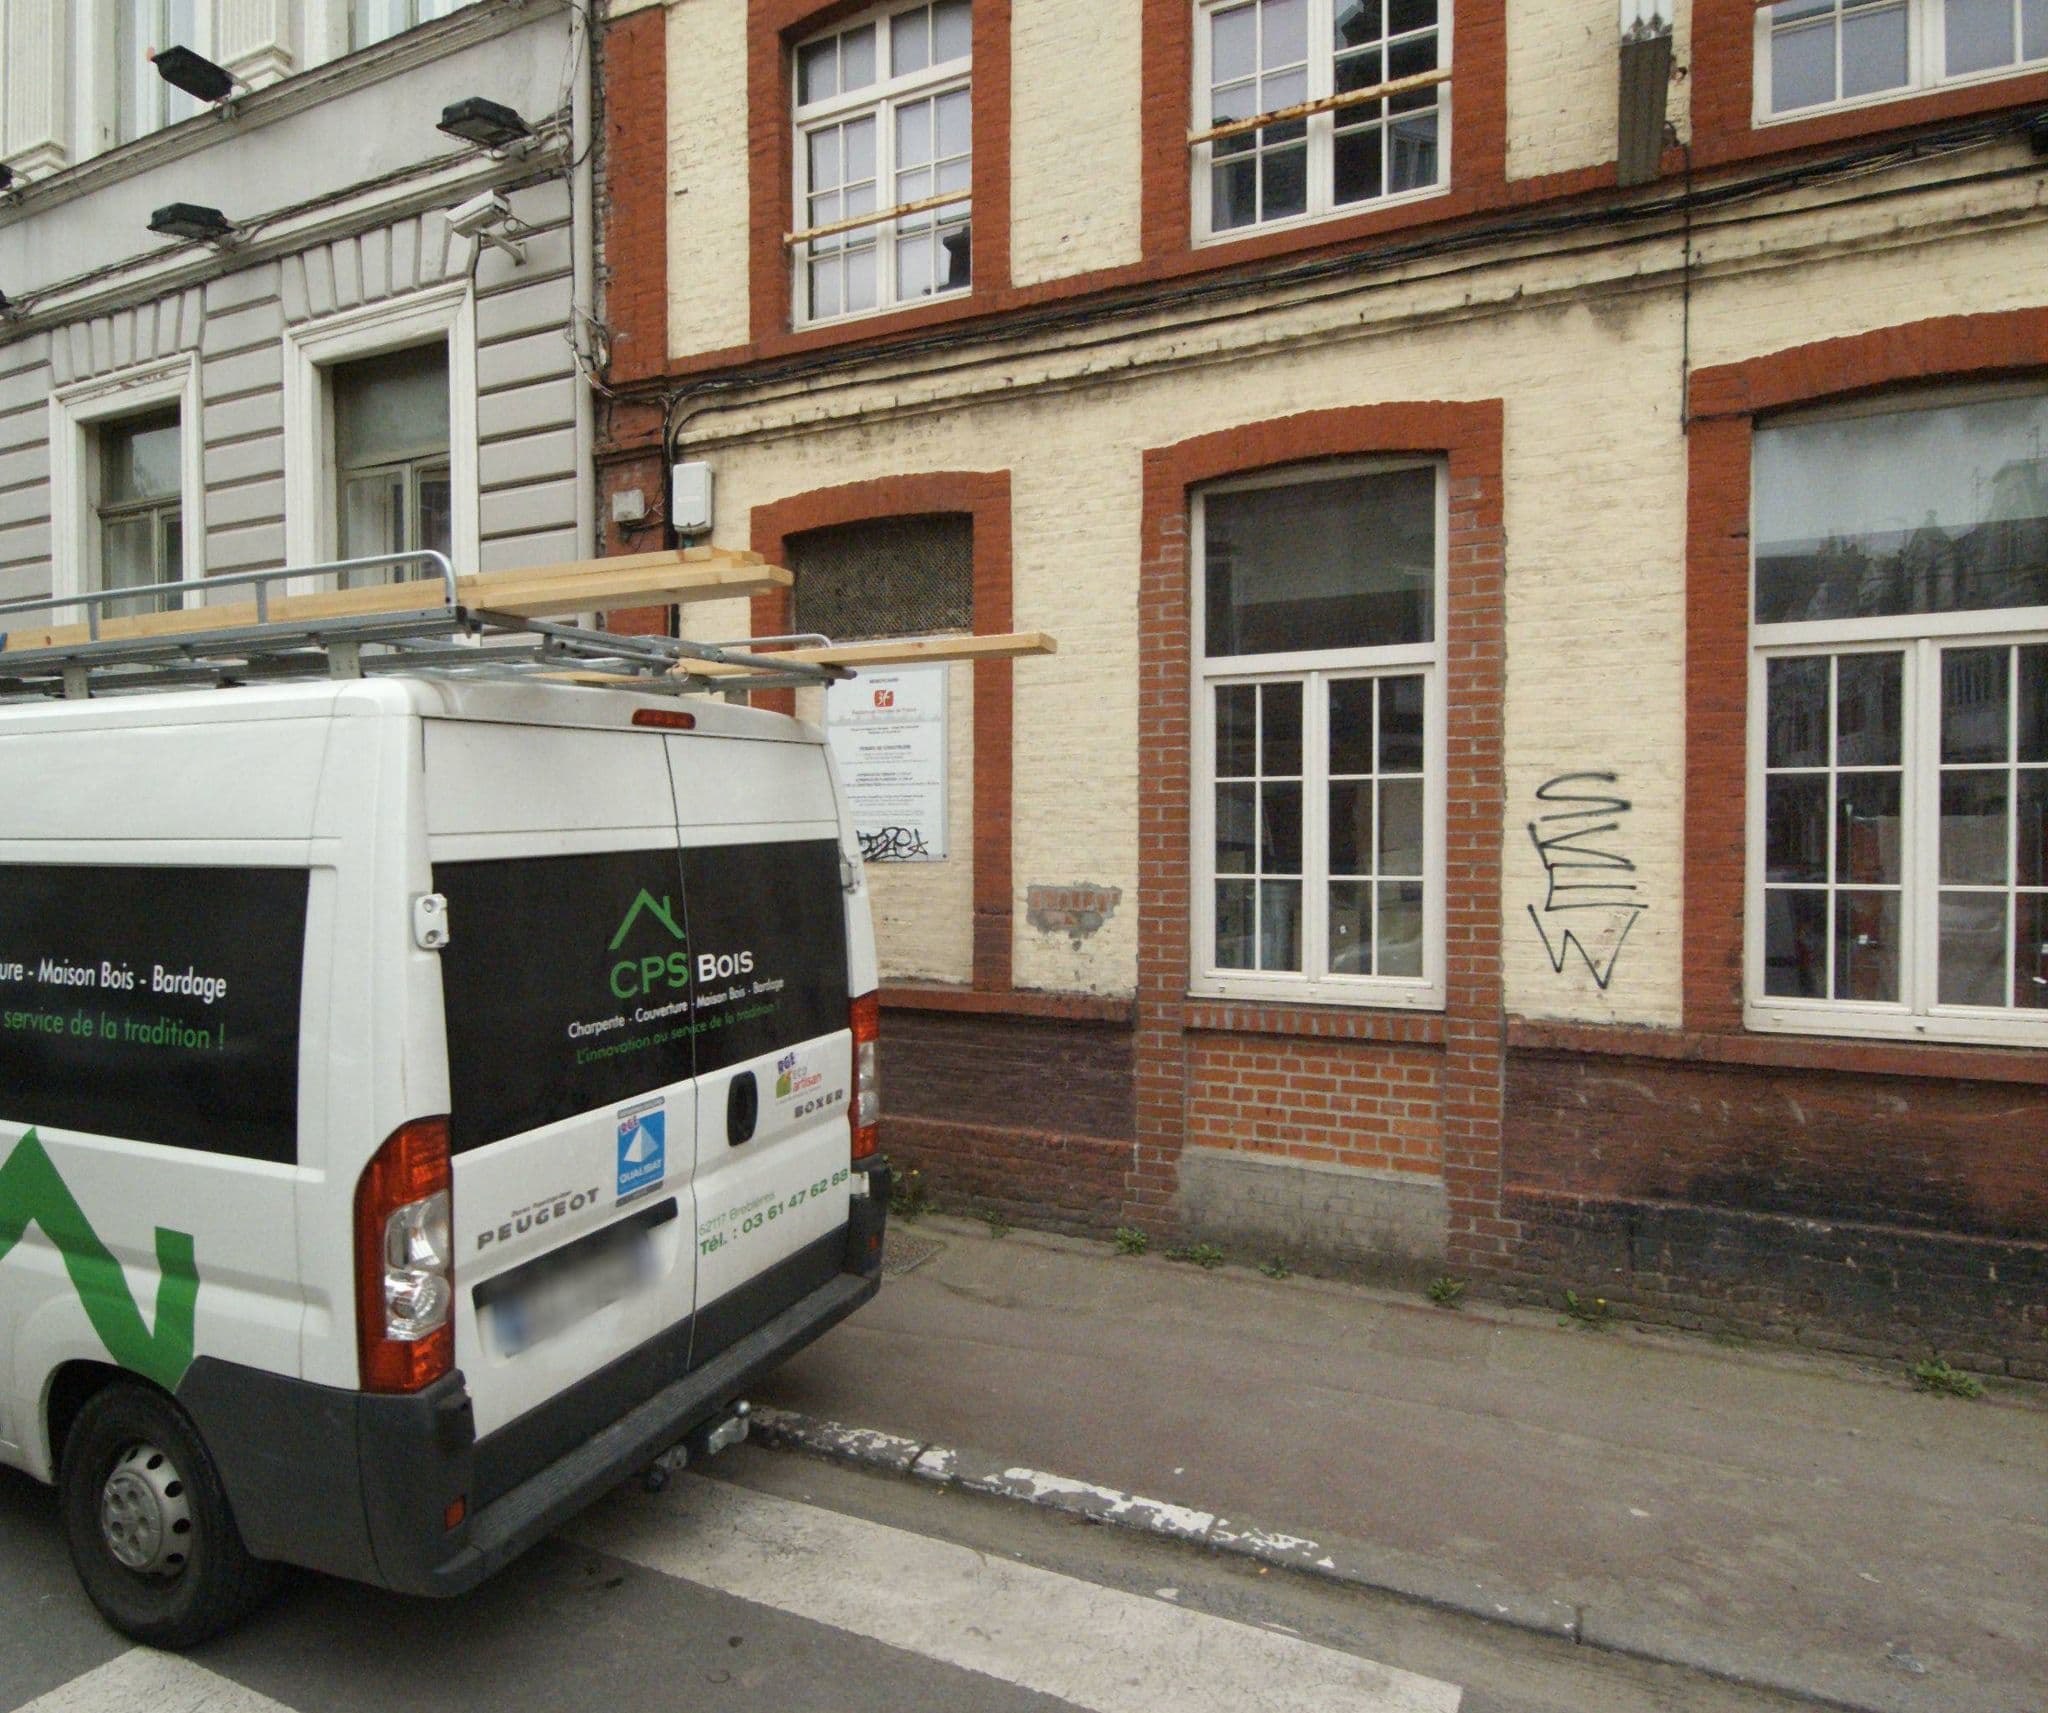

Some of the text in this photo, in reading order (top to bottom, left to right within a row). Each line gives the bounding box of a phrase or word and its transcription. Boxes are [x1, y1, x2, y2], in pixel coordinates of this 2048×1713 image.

[38, 957, 96, 987] Maison
[101, 961, 135, 991] Bois
[152, 965, 227, 1004] Bardage
[610, 952, 690, 999] CPS
[4, 1006, 64, 1034] service
[70, 1008, 93, 1037] de
[100, 1011, 117, 1039] la
[124, 1015, 210, 1049] tradition
[568, 1014, 626, 1039] Charpente
[635, 1001, 689, 1022] Couverture
[794, 1088, 844, 1119] BOXER
[477, 1186, 599, 1251] PEUGEOT
[742, 1212, 764, 1234] 03
[767, 1201, 785, 1221] 61
[788, 1189, 807, 1209] 47
[810, 1178, 828, 1198] 62
